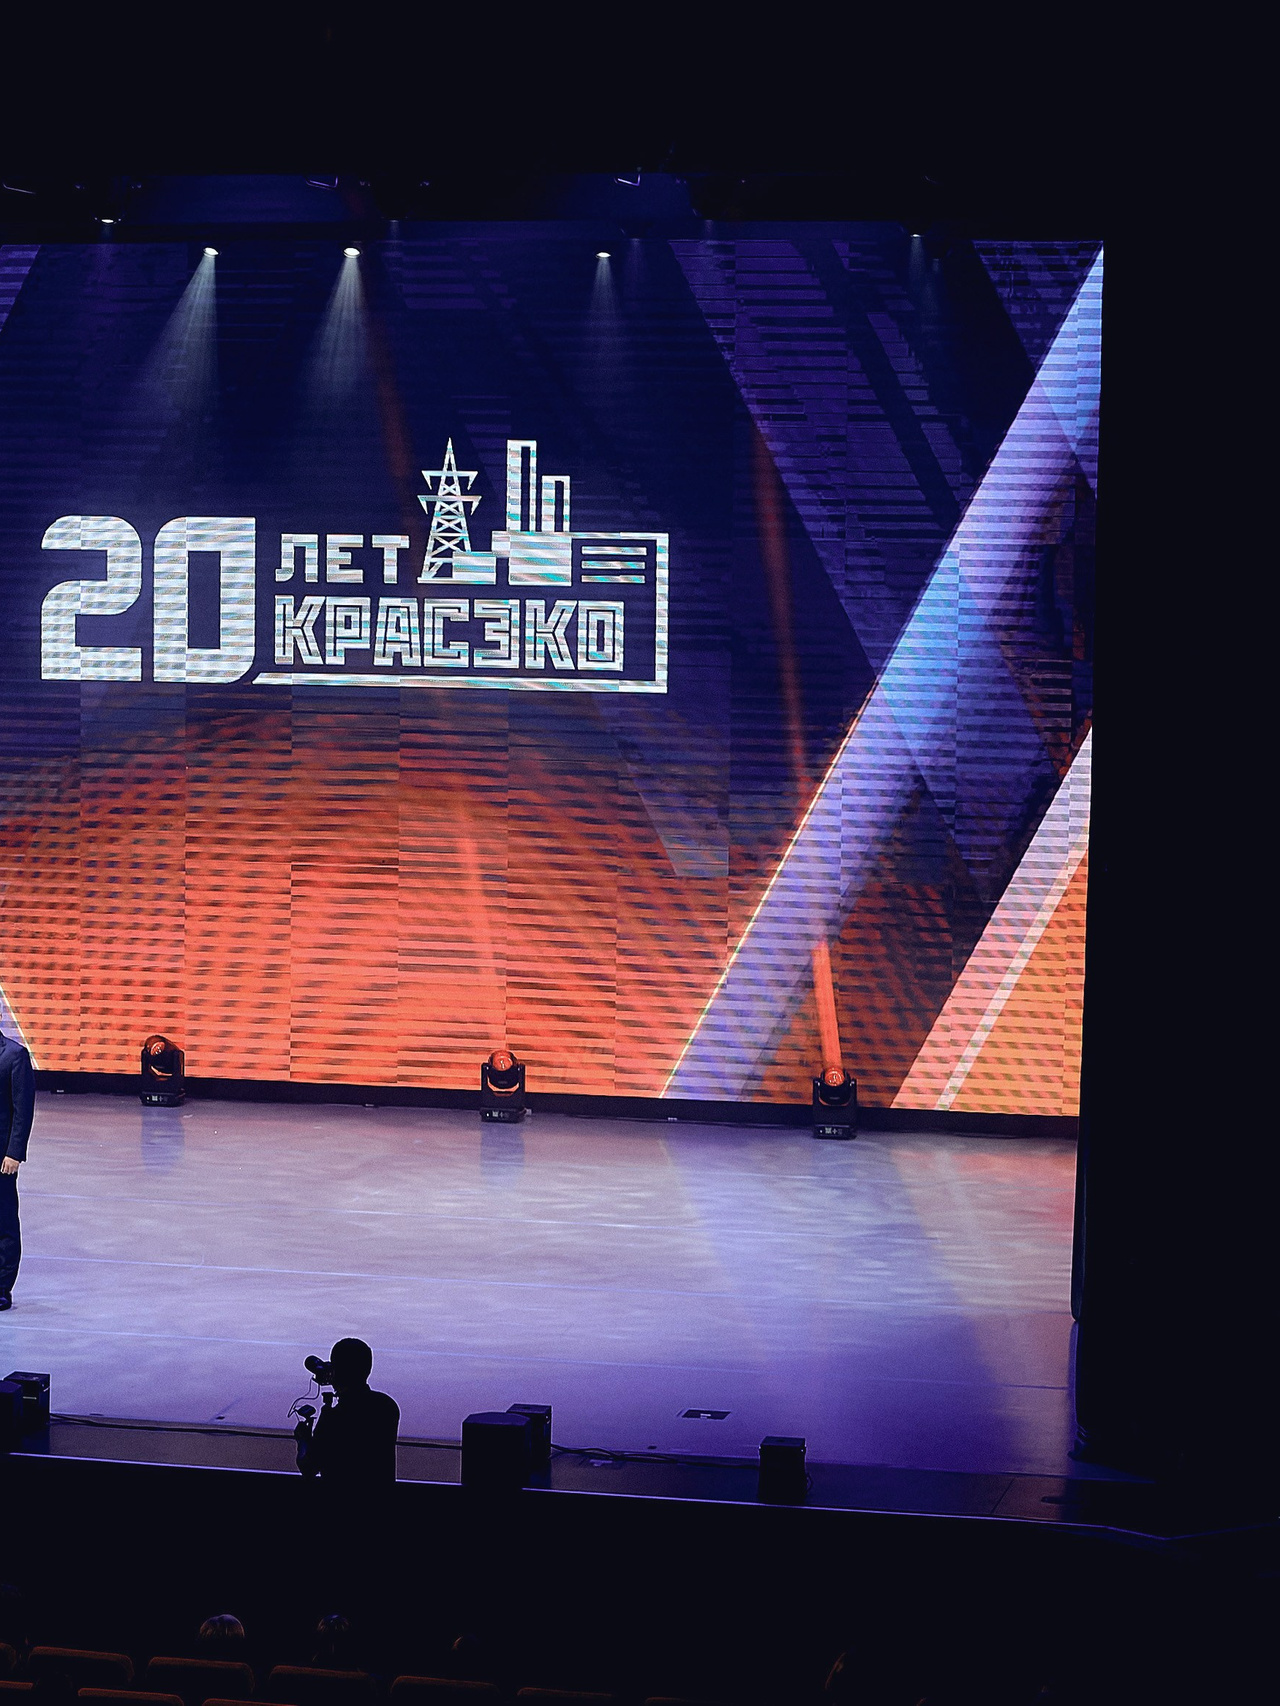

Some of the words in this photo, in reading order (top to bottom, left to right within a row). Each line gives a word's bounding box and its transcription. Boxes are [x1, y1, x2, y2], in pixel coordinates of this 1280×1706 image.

[41, 515, 256, 683] 20
[275, 533, 410, 584] ЛЕТ
[274, 595, 625, 672] КРАСЭКО
